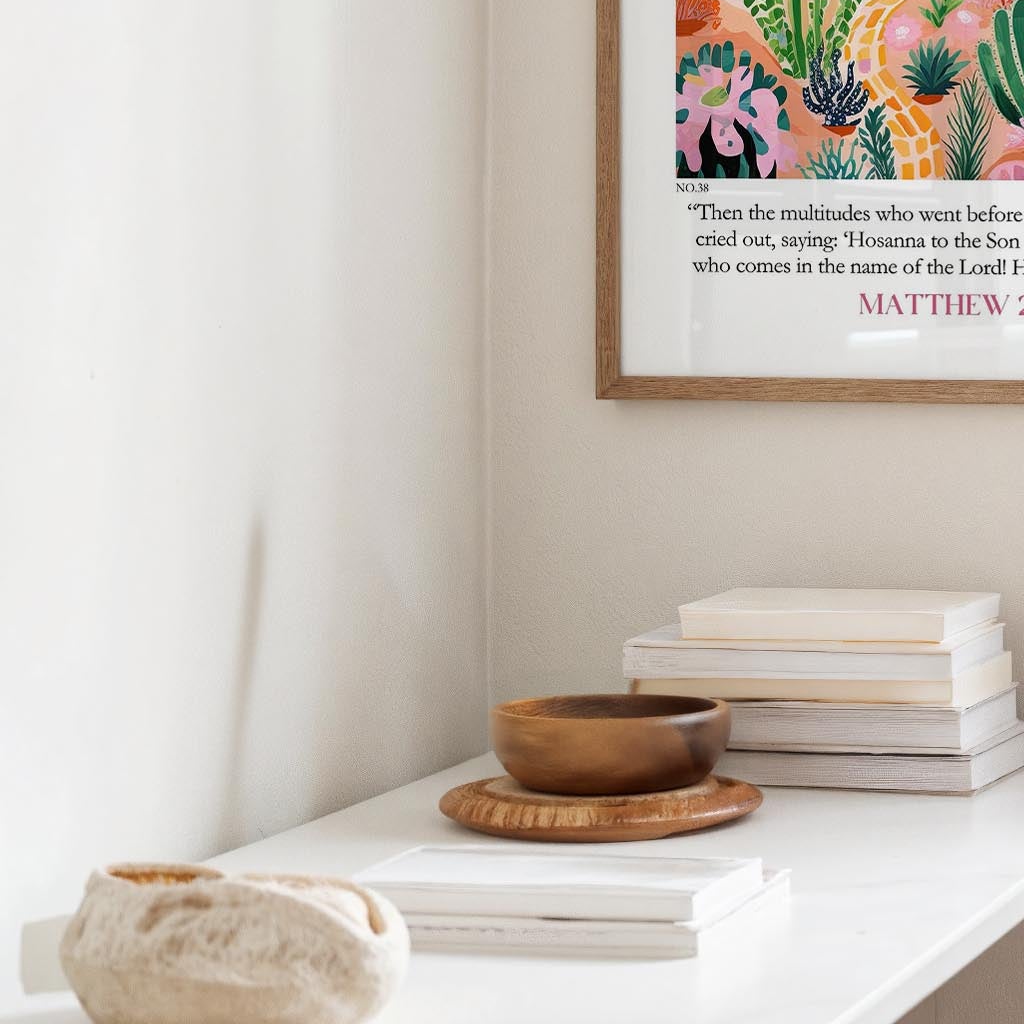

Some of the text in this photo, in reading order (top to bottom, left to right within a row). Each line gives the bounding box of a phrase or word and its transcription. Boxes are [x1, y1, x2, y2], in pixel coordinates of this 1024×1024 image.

[675, 182, 709, 193] NO.38
[749, 203, 775, 220] the
[781, 204, 870, 221] multitudes
[875, 205, 914, 221] who
[919, 210, 962, 222] went
[967, 205, 1023, 222] before
[696, 230, 737, 246] cried
[743, 234, 775, 251] out,
[782, 231, 837, 253] saying:
[931, 236, 948, 248] to
[954, 232, 981, 248] the
[986, 232, 1020, 249] Son
[692, 257, 730, 273] who
[736, 262, 790, 273] comes
[796, 258, 812, 273] in
[818, 258, 845, 274] the
[850, 263, 897, 274] name
[903, 258, 924, 274] of
[927, 258, 954, 275] the
[959, 259, 1006, 275] Lord!
[860, 293, 1010, 315] MATTHEW
